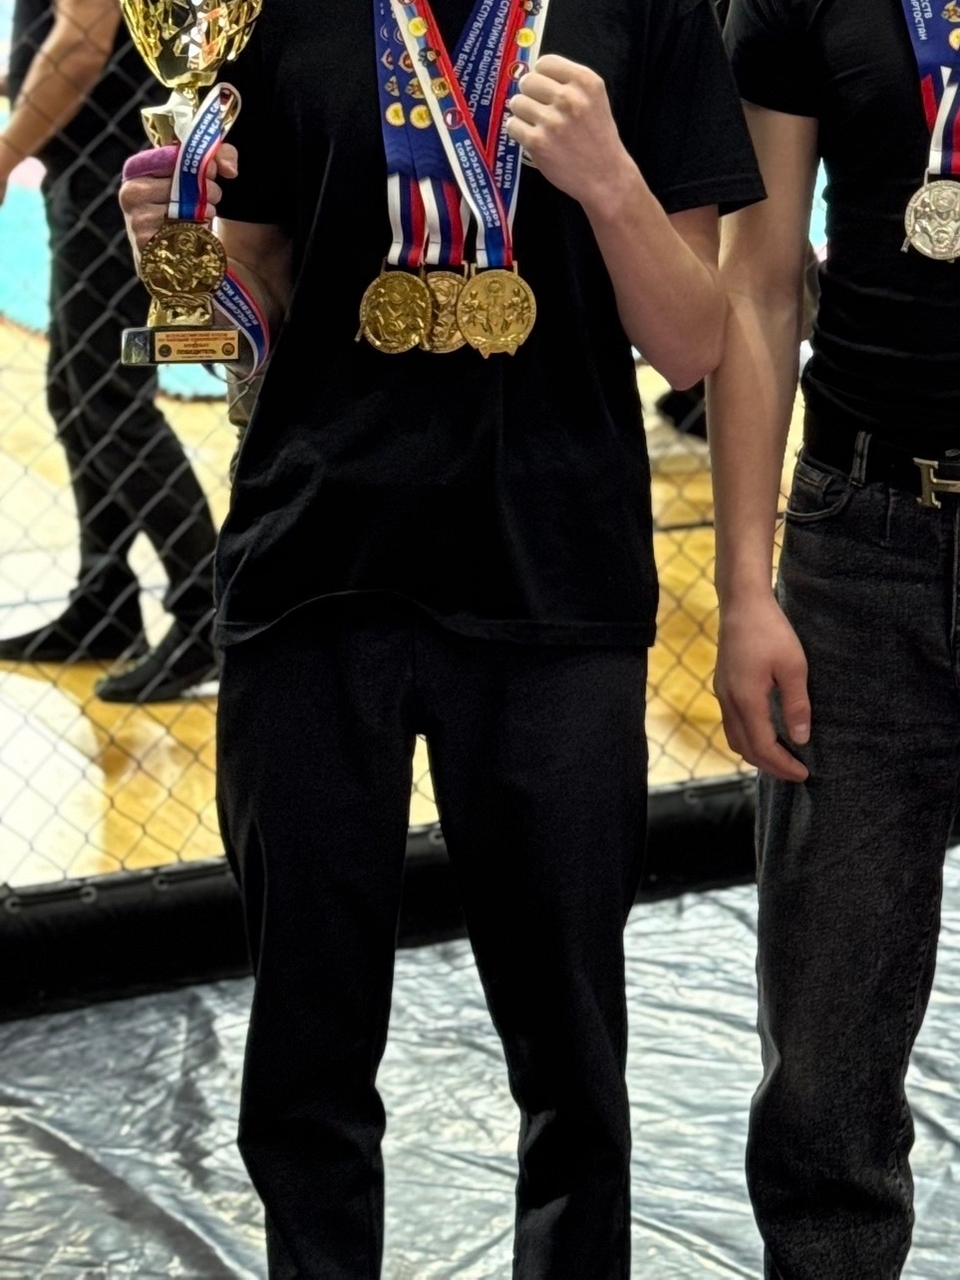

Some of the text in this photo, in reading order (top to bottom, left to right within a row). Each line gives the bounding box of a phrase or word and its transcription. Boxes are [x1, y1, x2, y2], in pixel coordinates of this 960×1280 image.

[468, 48, 494, 118] БАШКОРТОСТ
[190, 134, 212, 175] БОЕВЫХ
[455, 142, 470, 168] СОЮЗ
[463, 139, 487, 186] ИСКУССТВ
[503, 154, 515, 189] UNION
